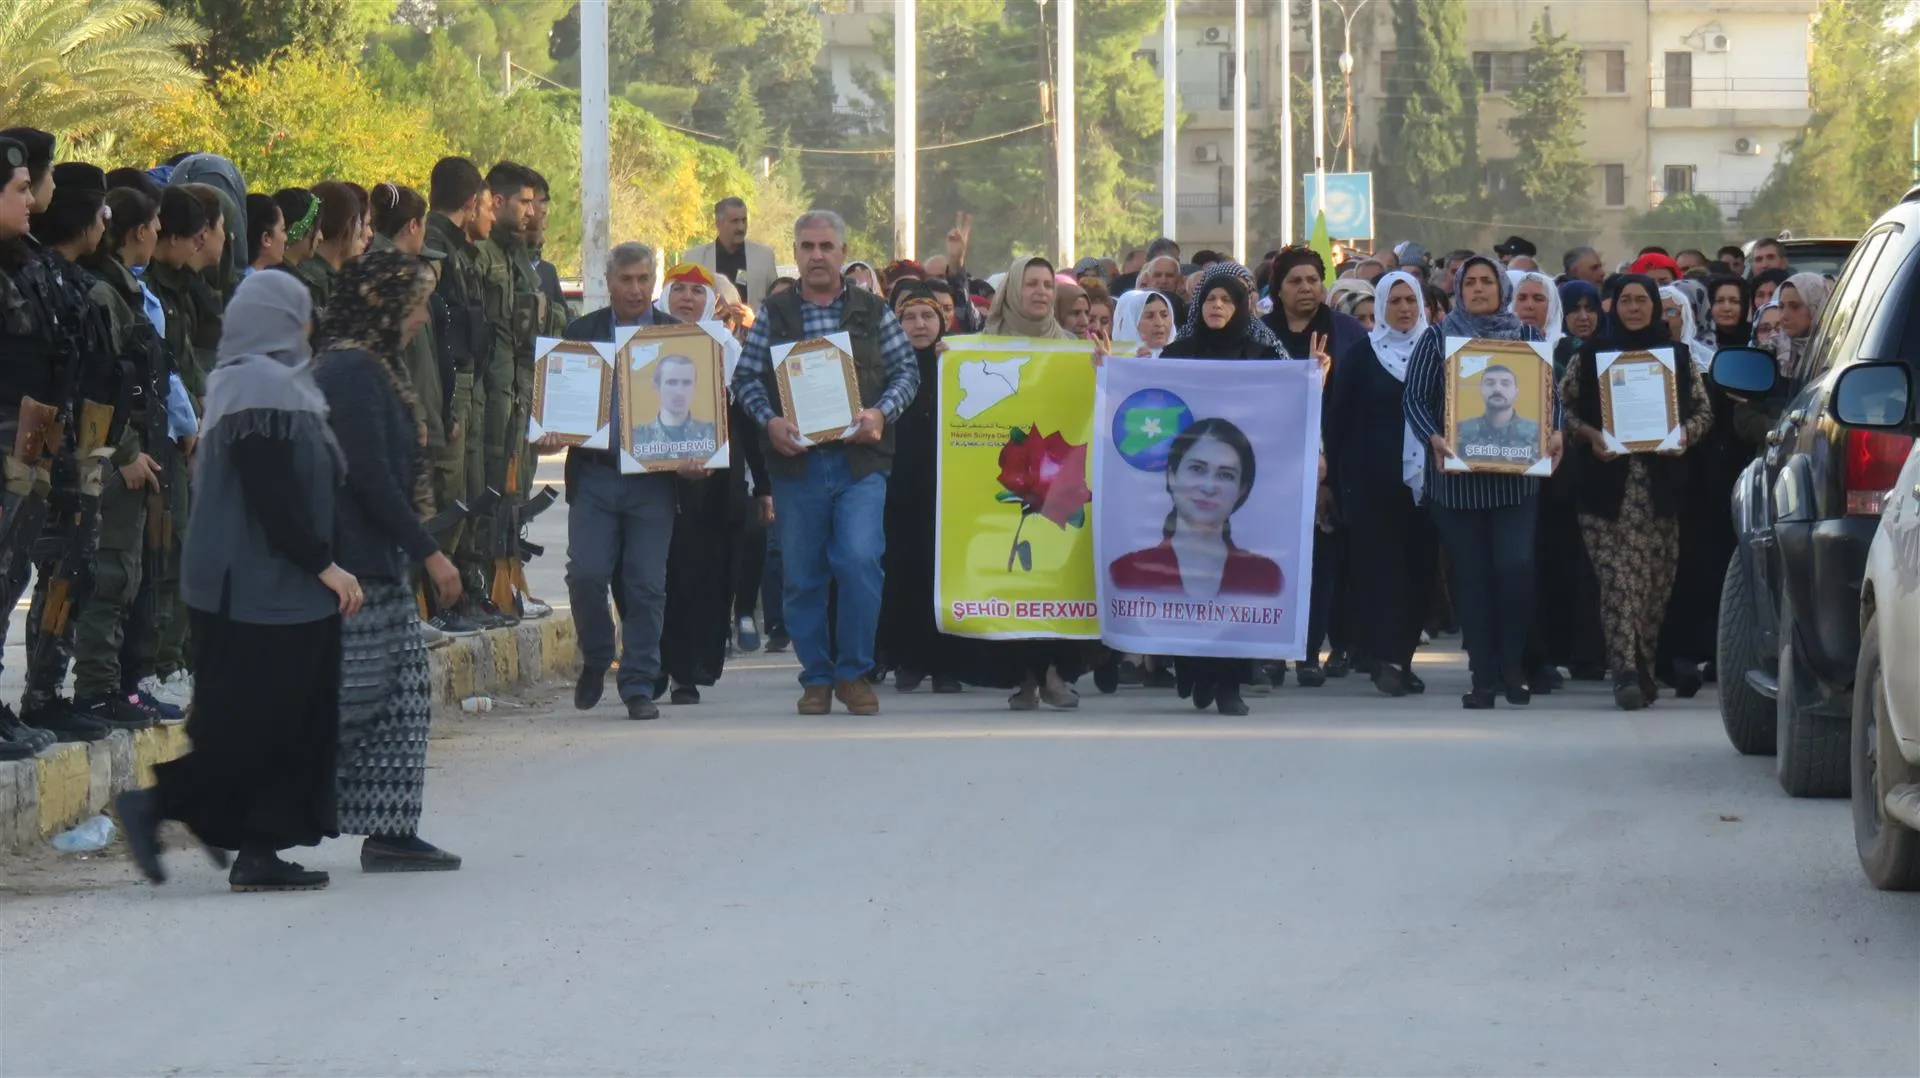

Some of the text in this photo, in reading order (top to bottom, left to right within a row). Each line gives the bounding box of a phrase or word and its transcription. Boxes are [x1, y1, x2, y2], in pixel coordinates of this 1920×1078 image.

[953, 599, 1010, 618] ŞEHÎD
[1111, 596, 1283, 624] ŞEHÎD HEVRÎN XELEF
